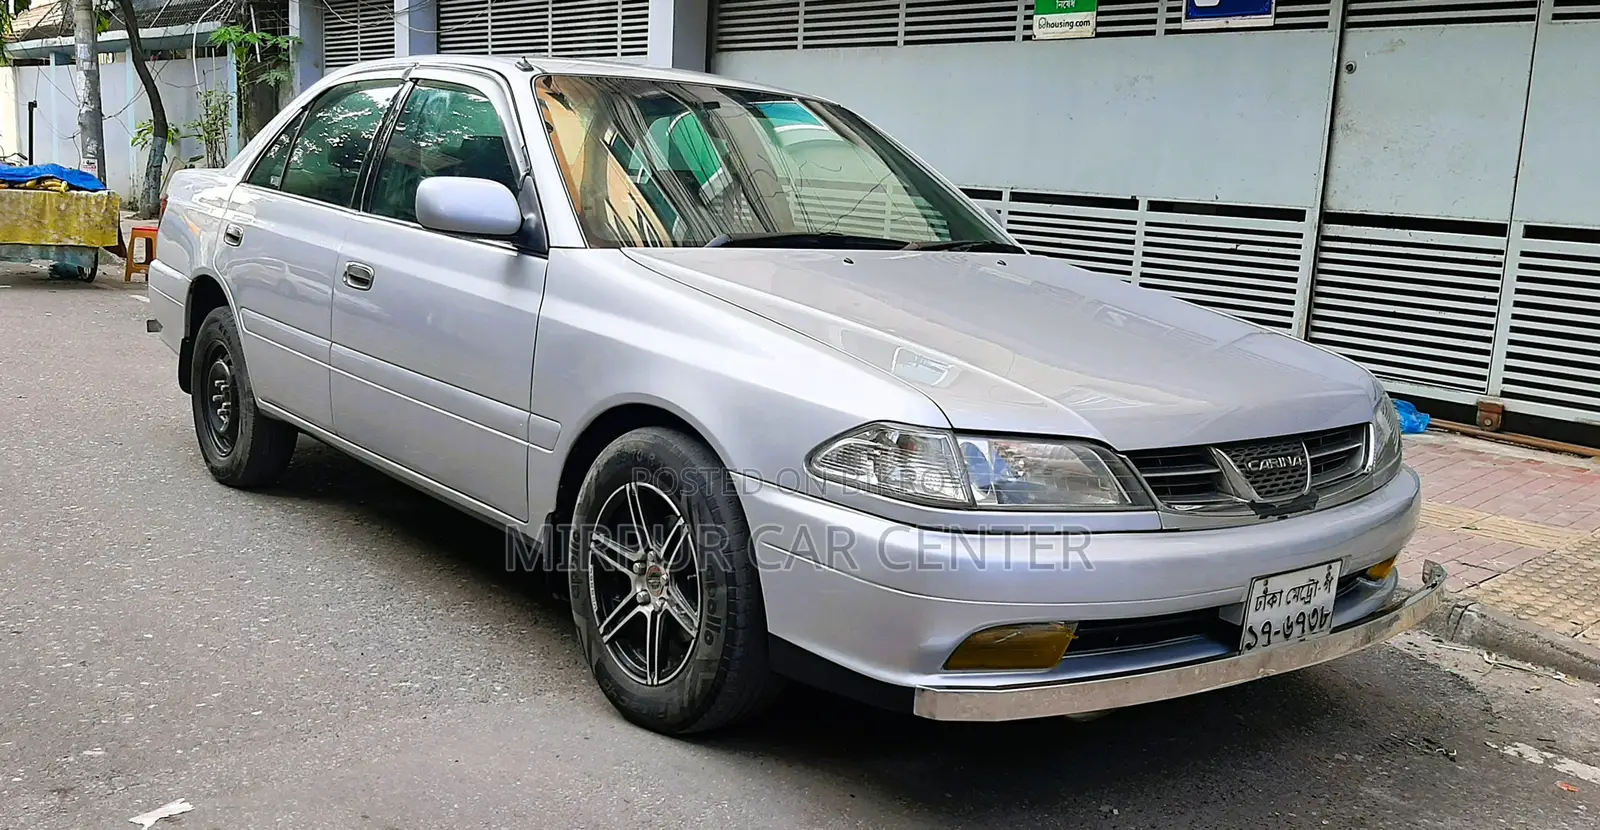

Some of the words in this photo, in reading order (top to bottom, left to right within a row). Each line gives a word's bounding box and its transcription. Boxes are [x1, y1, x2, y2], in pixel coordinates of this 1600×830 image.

[1247, 456, 1303, 472] CARINA
[1254, 589, 1284, 612] ঢাকা
[1245, 605, 1331, 651] ১৭-৬৭৩৮
